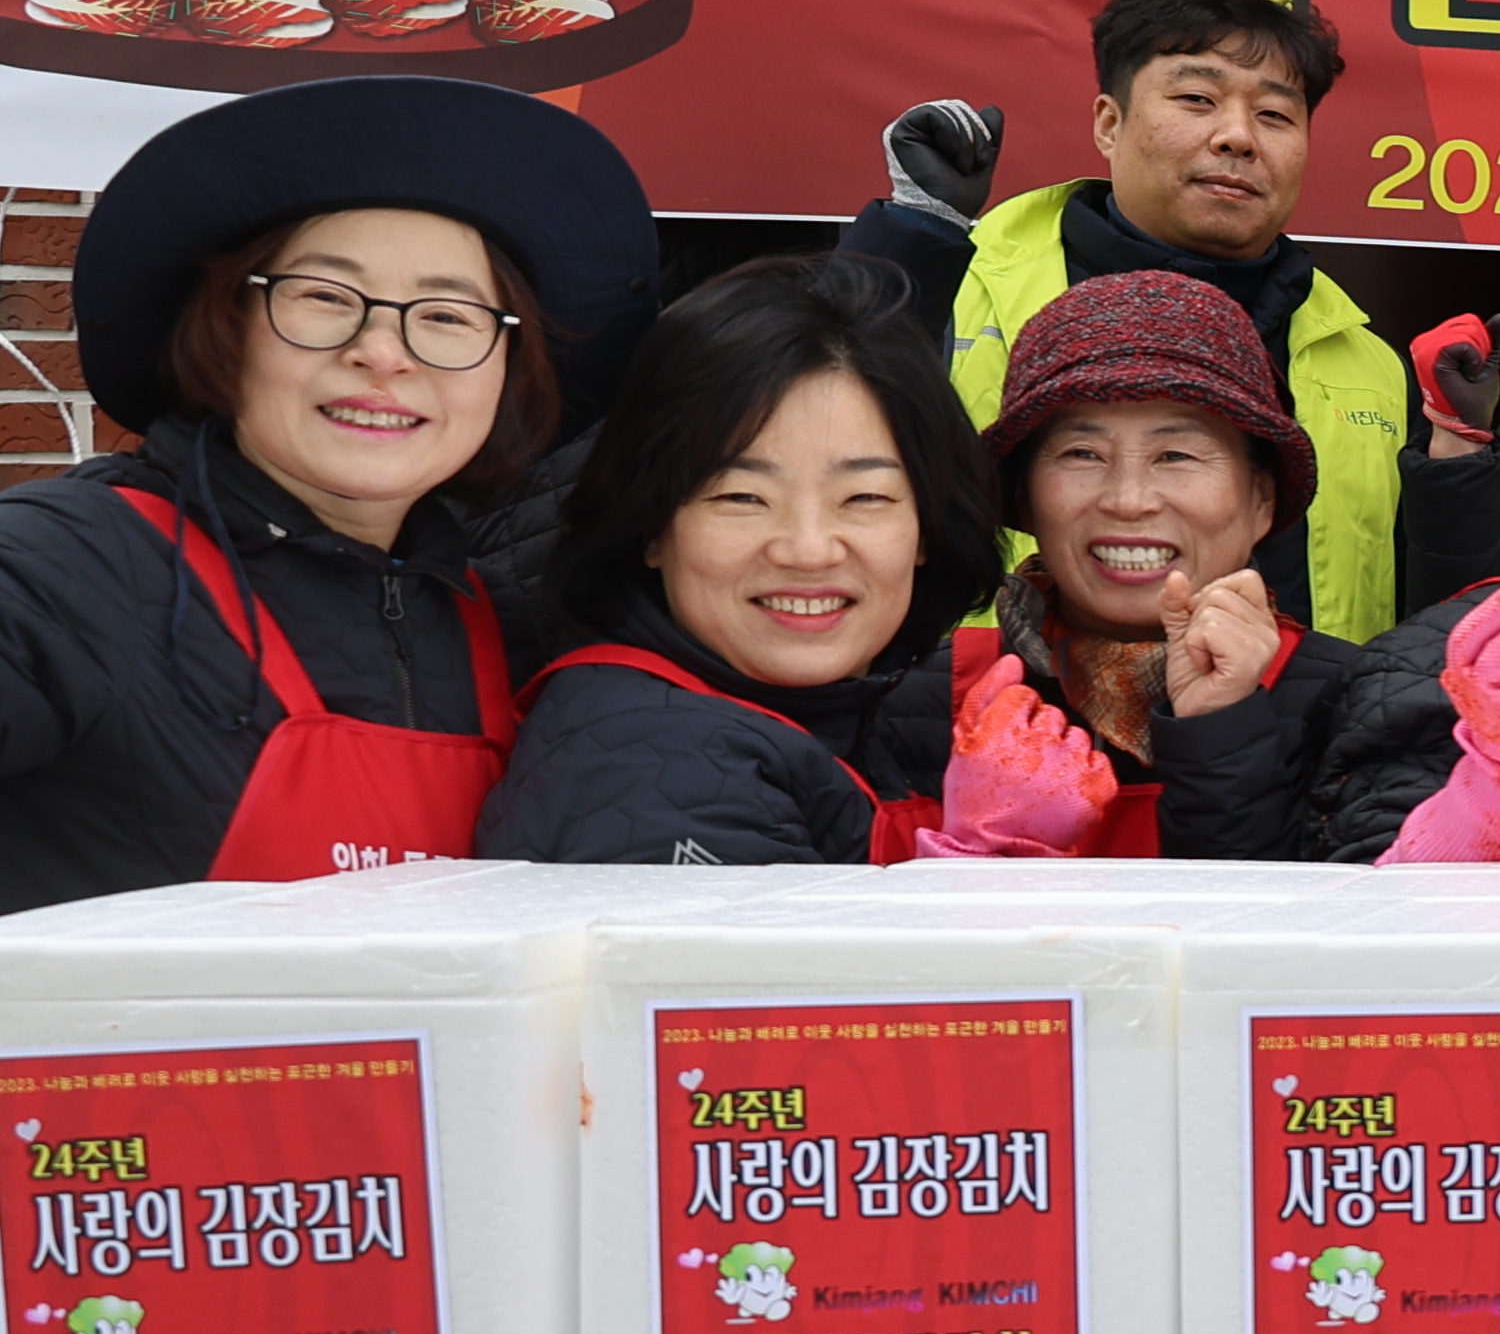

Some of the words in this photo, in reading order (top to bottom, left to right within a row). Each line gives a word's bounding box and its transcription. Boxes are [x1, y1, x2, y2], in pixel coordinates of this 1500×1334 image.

[691, 1087, 805, 1131] 24주년
[30, 1136, 146, 1182] 24주년
[687, 1137, 838, 1223] 사랑의
[853, 1130, 1049, 1218] 김장김치
[31, 1187, 186, 1276] 사랑의
[198, 1175, 405, 1268] 김장김치
